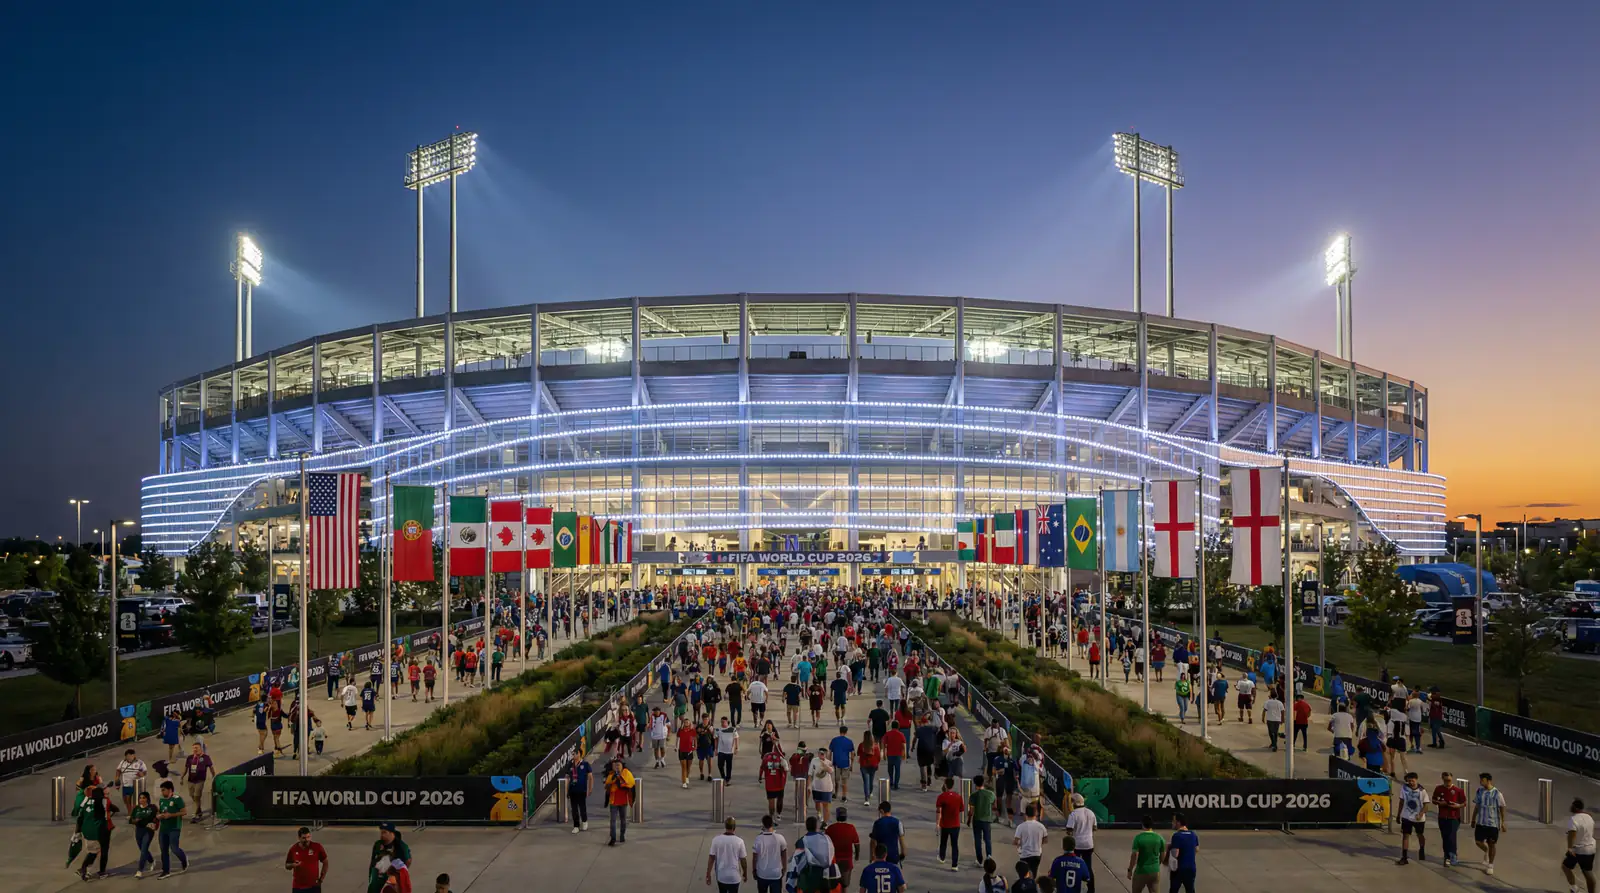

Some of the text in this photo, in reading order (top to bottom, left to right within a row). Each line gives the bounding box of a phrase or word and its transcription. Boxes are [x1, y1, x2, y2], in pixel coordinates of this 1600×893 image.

[728, 553, 871, 562] FIFA WORLD CUP 2026
[163, 702, 181, 717] FIFA
[210, 691, 225, 704] CUP
[224, 686, 241, 701] 2026
[0, 722, 109, 763] FIFA WORLD CUP 2026
[1503, 723, 1600, 762] FIFA WORLD CUP 20
[272, 790, 465, 805] FIFA WORLD CUP 2026
[1137, 793, 1331, 808] FIFA WORLD CUP 2026
[874, 874, 891, 893] 16
[1065, 870, 1076, 888] 8
